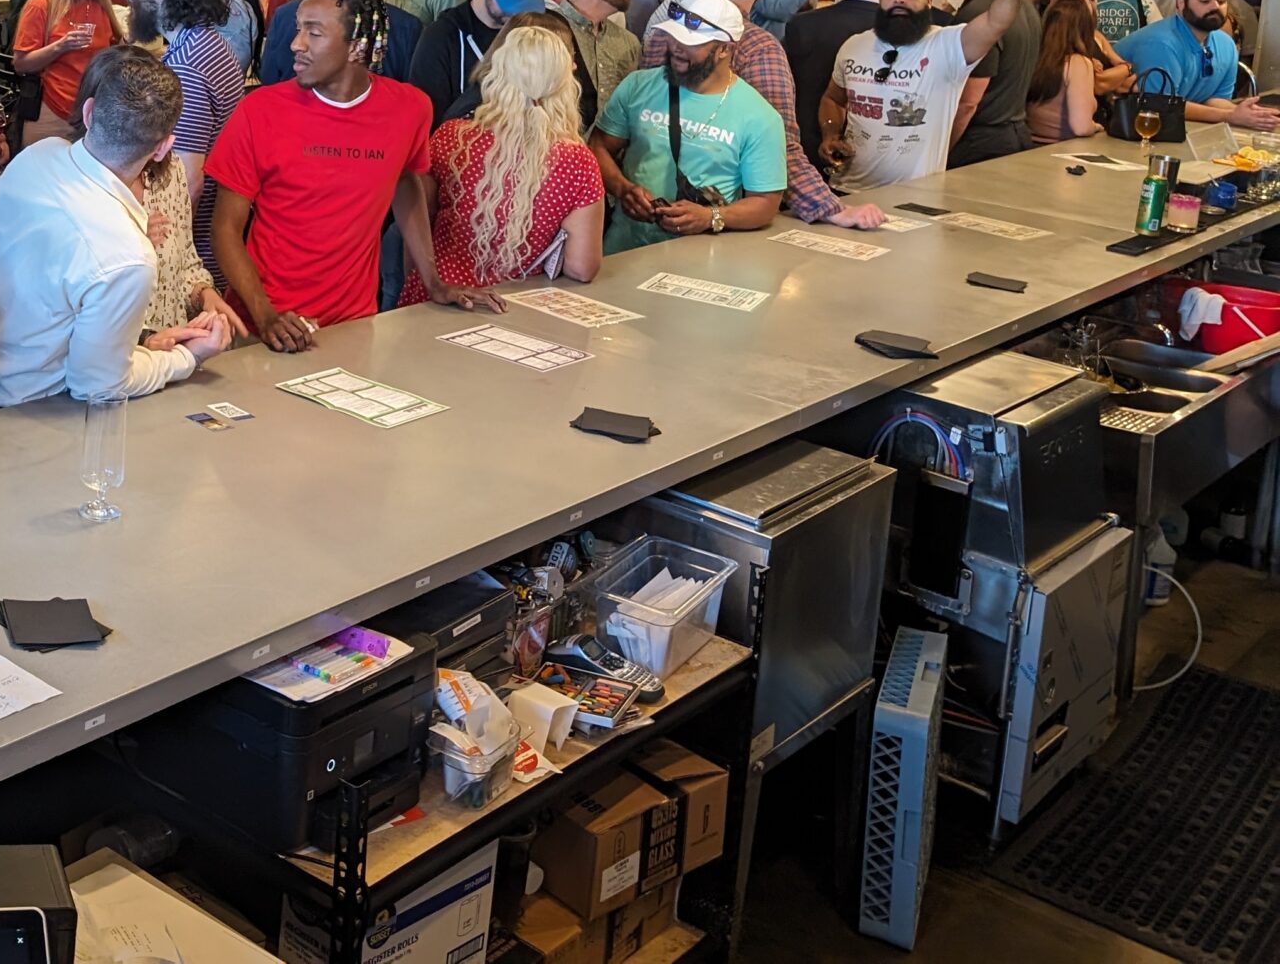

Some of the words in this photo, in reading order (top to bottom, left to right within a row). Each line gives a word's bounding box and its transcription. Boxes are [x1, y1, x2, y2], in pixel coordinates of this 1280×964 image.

[1097, 8, 1132, 17] RIDGE
[346, 147, 360, 158] TO
[364, 150, 385, 160] IAN
[548, 544, 563, 567] CIDE
[648, 841, 675, 865] GLASS
[398, 934, 419, 953] ROLLS
